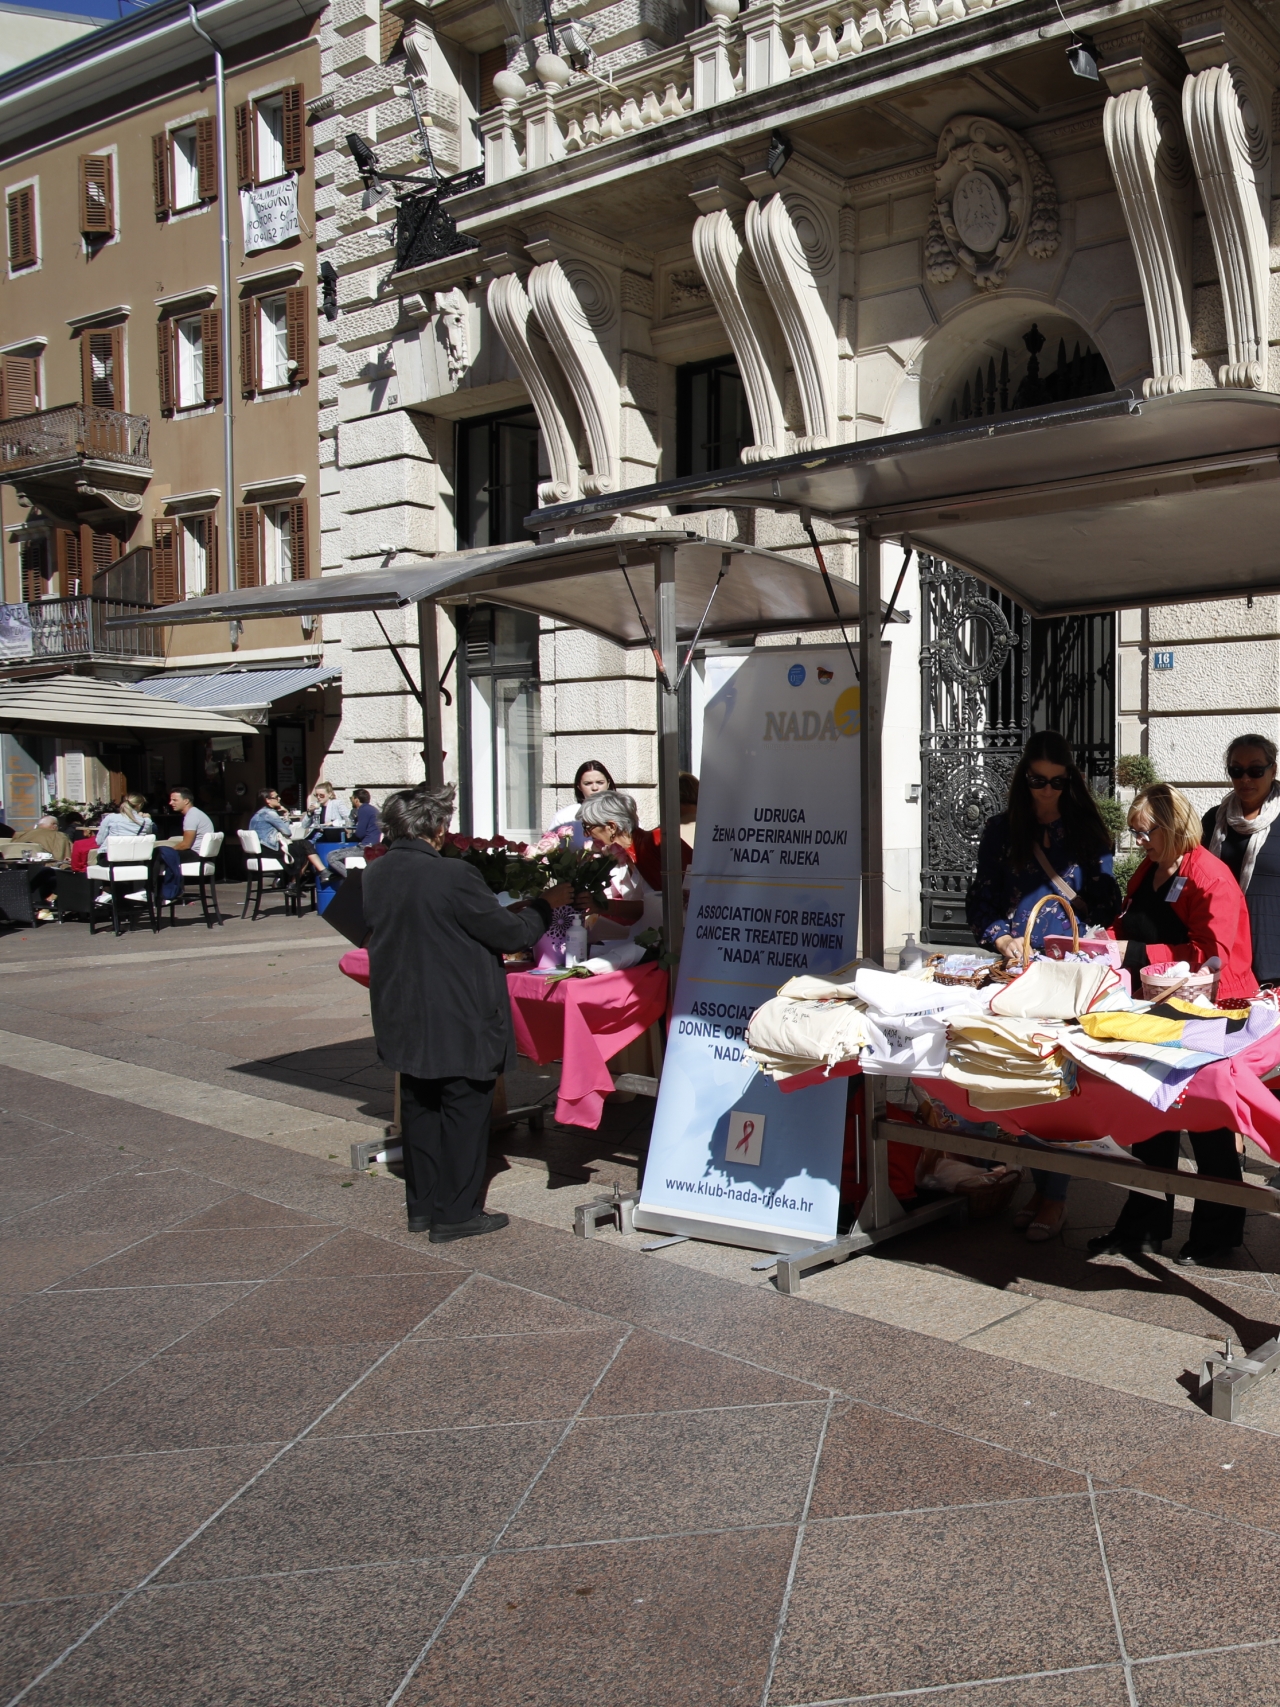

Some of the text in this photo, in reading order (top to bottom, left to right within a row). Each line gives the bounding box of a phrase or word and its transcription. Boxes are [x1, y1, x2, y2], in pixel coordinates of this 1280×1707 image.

[256, 195, 291, 213] OSLOVNI
[247, 213, 273, 230] ROSTOR
[1158, 653, 1170, 664] 16
[762, 709, 837, 741] NADA
[754, 807, 806, 823] UDRUGA
[712, 825, 848, 845] ŽENA OPERIRANIH DOJKI
[779, 850, 820, 866] RIJEKA
[697, 904, 845, 928] ASSOCIATION FOR BREAST
[696, 925, 843, 950] CANCER TREATED WOMEN
[767, 951, 808, 969] RIJEKA
[691, 1001, 758, 1020] ASSOCIAZ
[678, 1020, 721, 1039] DONNE
[665, 1178, 814, 1213] www.klub-nada-rijeka.hr
